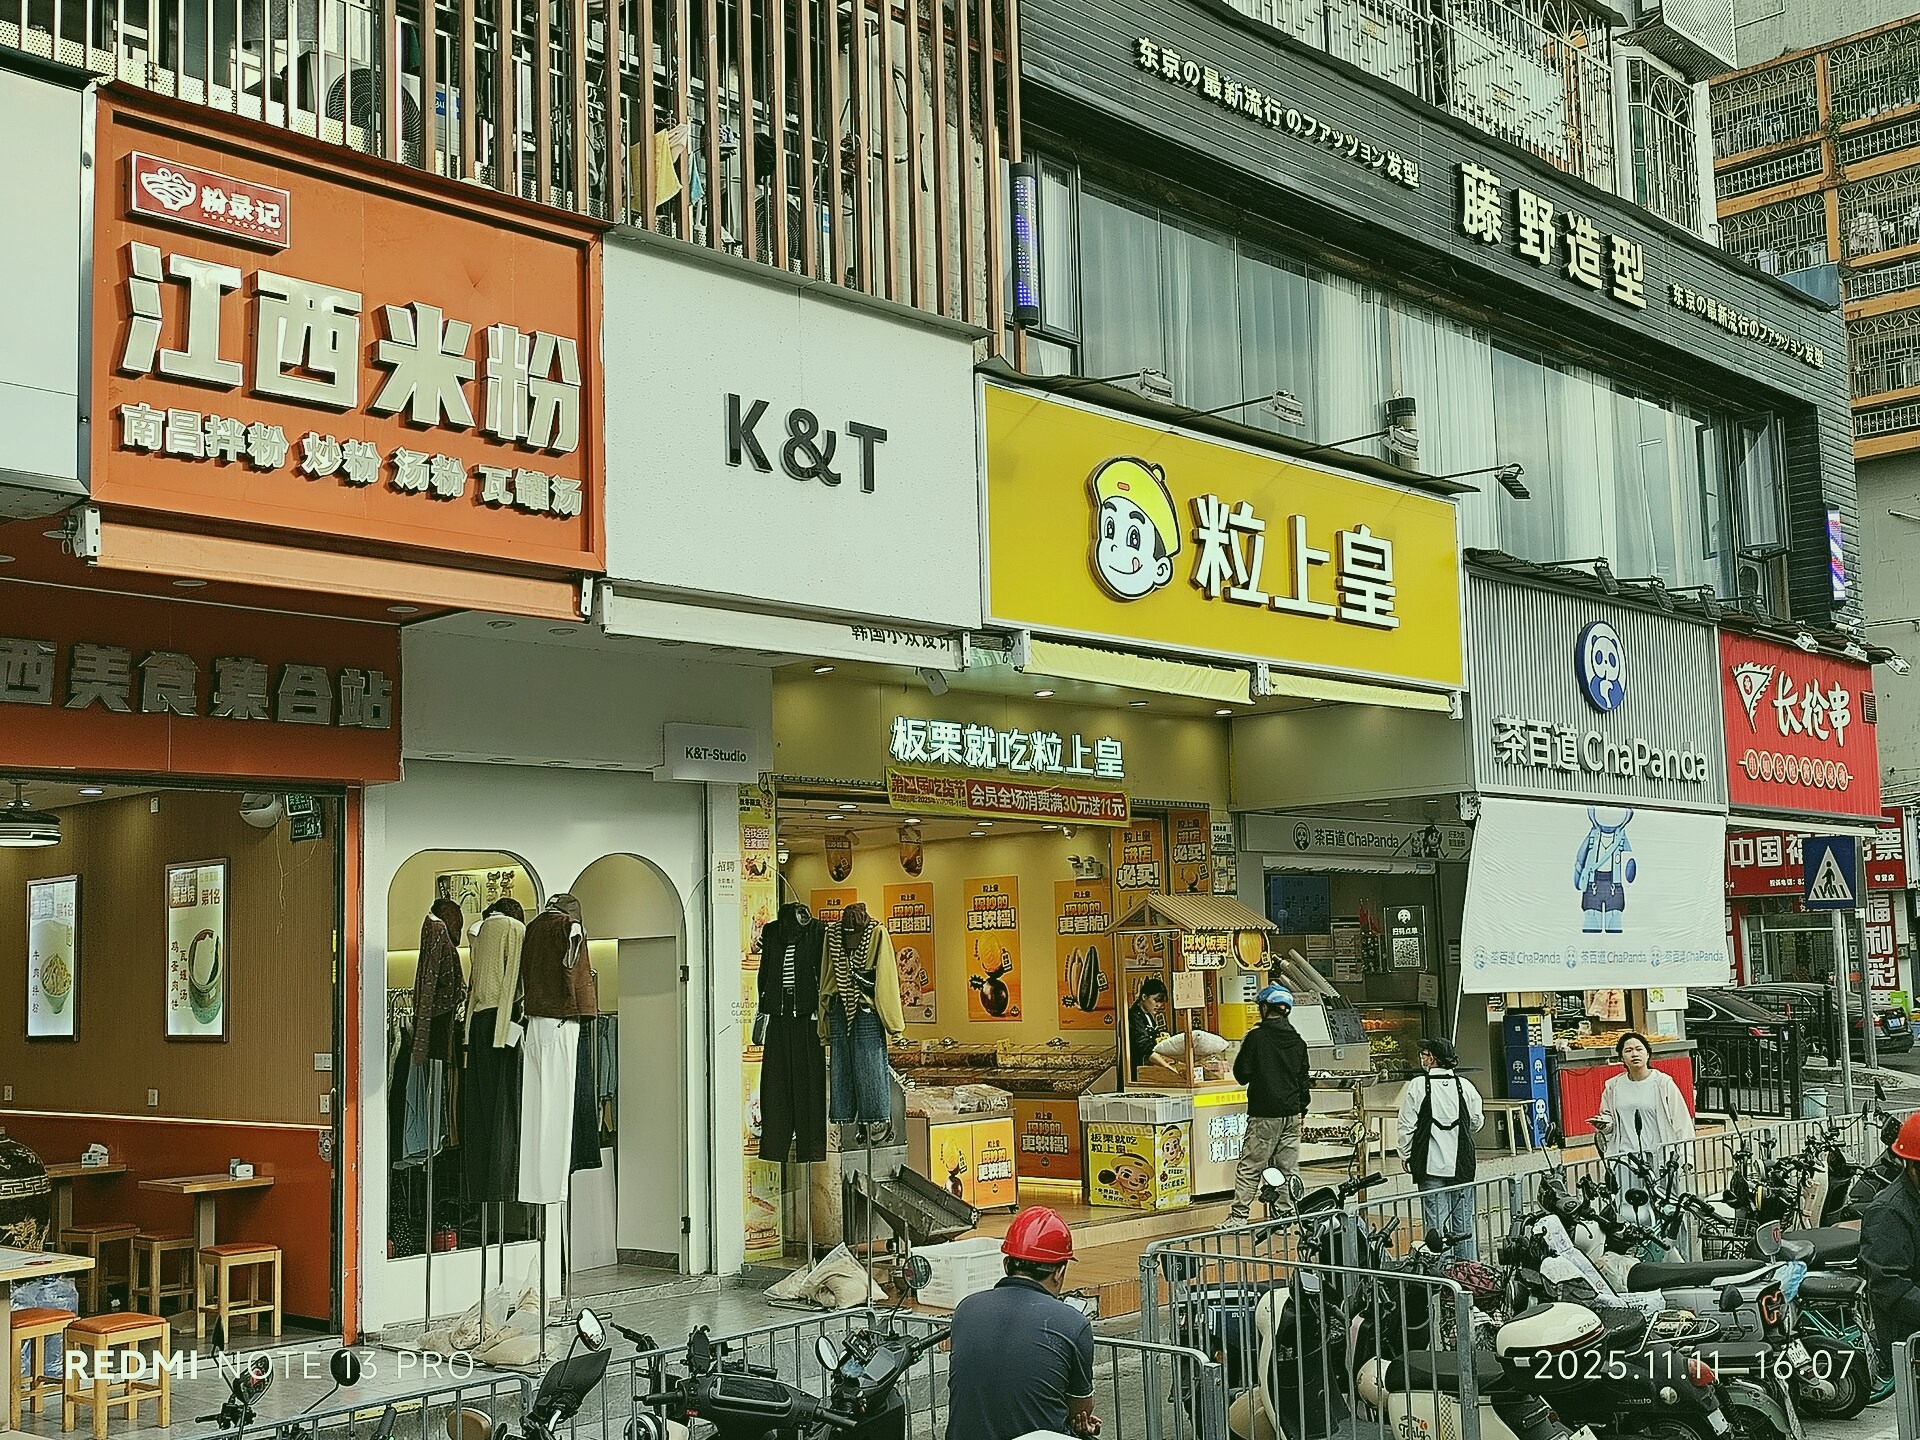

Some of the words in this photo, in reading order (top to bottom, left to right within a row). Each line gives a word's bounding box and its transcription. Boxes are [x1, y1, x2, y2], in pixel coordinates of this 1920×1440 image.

[201, 186, 282, 229] 粉录记
[1461, 161, 1648, 311] 藤野造型
[119, 241, 581, 455] 江西米粉
[120, 402, 288, 469] 南昌拌粉
[303, 432, 381, 483] 炒粉
[394, 446, 468, 497] 汤粉
[479, 463, 583, 516] 瓦罐汤
[724, 392, 888, 494] K&T
[1188, 493, 1401, 630] 粒上皇
[1772, 671, 1851, 747] 长枪串
[685, 746, 748, 763] K&T-Studio
[890, 716, 1126, 780] 板栗就吃粒上皇
[970, 783, 1126, 818] 会员全场消费满30元送11元
[1123, 830, 1151, 843] 粒上皇
[1117, 861, 1159, 887] 必买!
[967, 908, 1015, 929] 更软糯!
[1184, 934, 1228, 952] 现炒板栗
